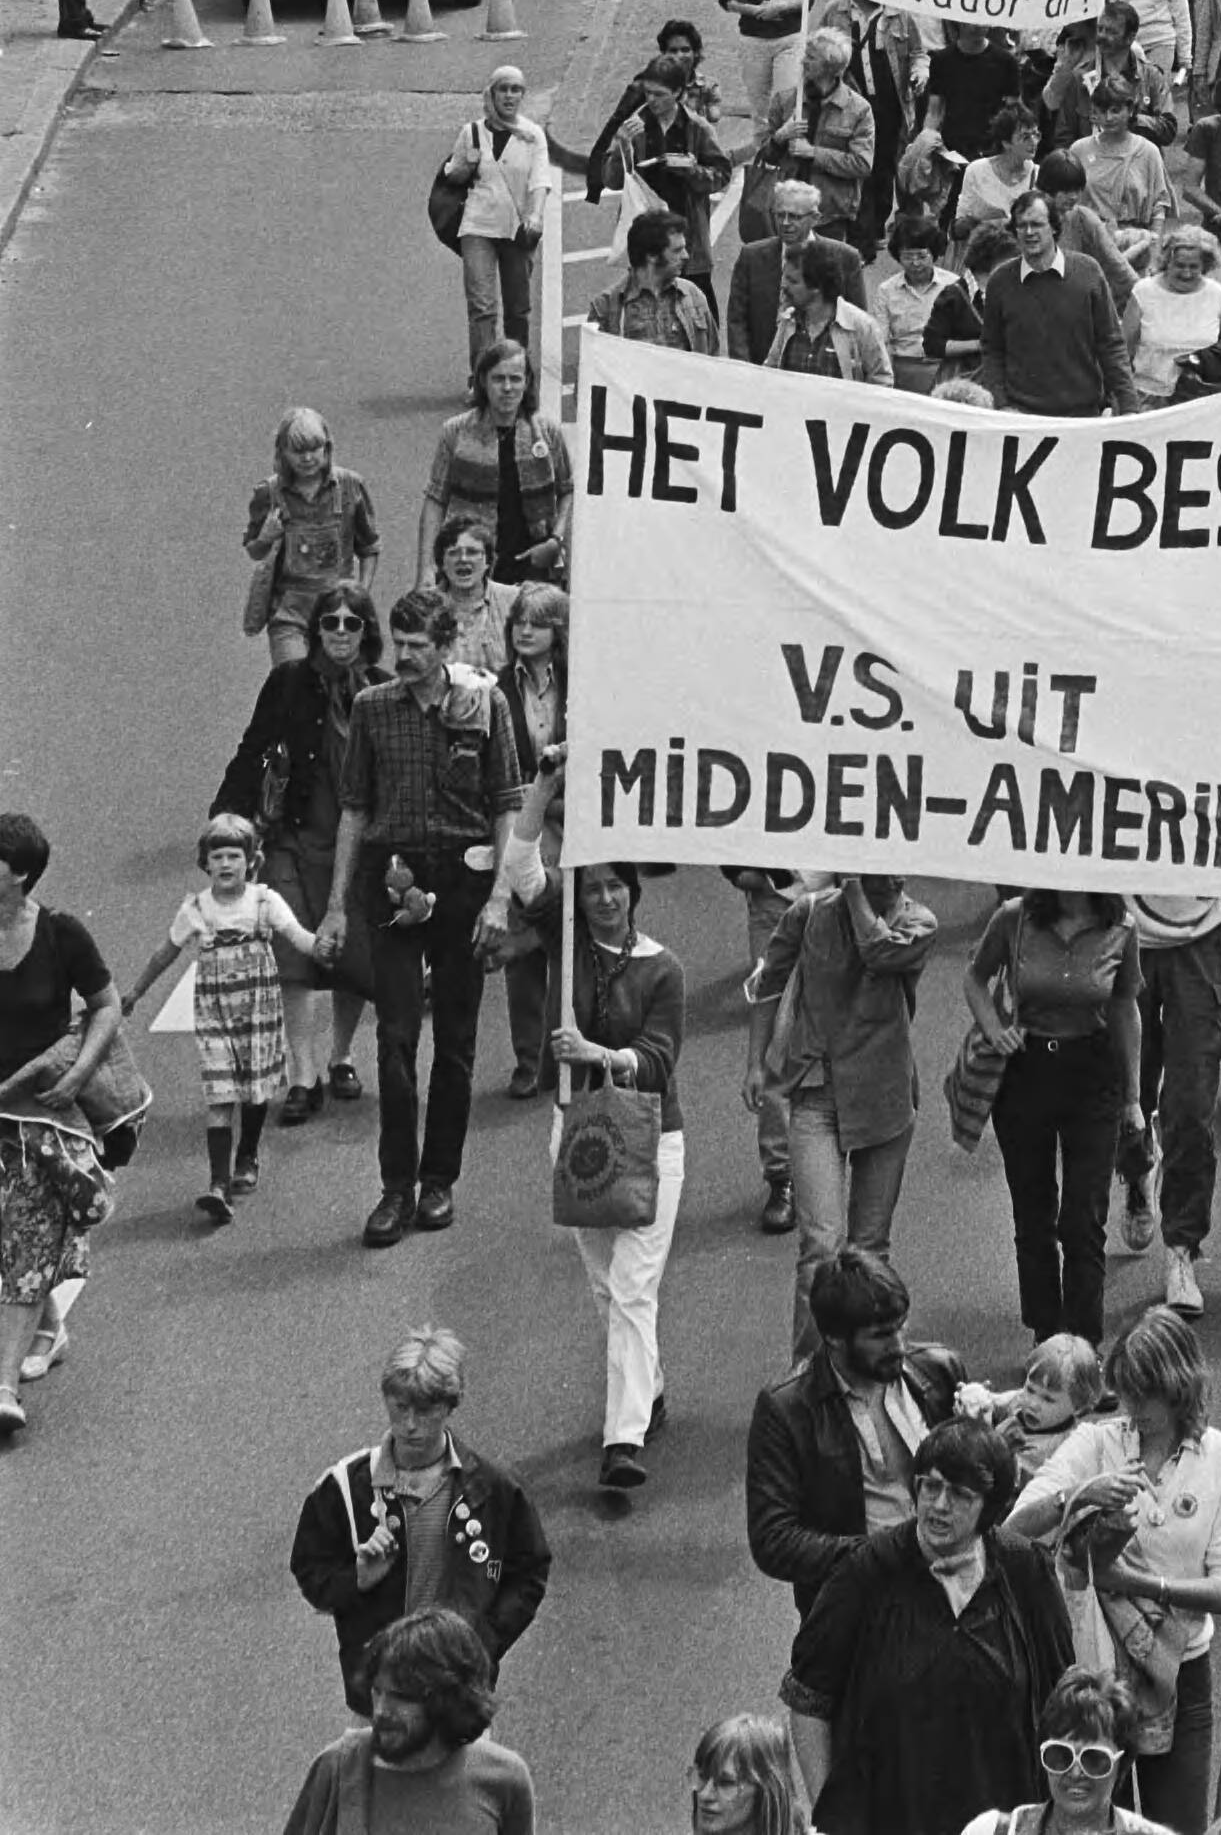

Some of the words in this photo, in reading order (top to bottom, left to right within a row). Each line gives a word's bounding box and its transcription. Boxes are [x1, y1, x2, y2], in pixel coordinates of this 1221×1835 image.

[587, 386, 762, 512] HET
[806, 421, 1058, 544] VOLK
[781, 645, 914, 733] V.S.
